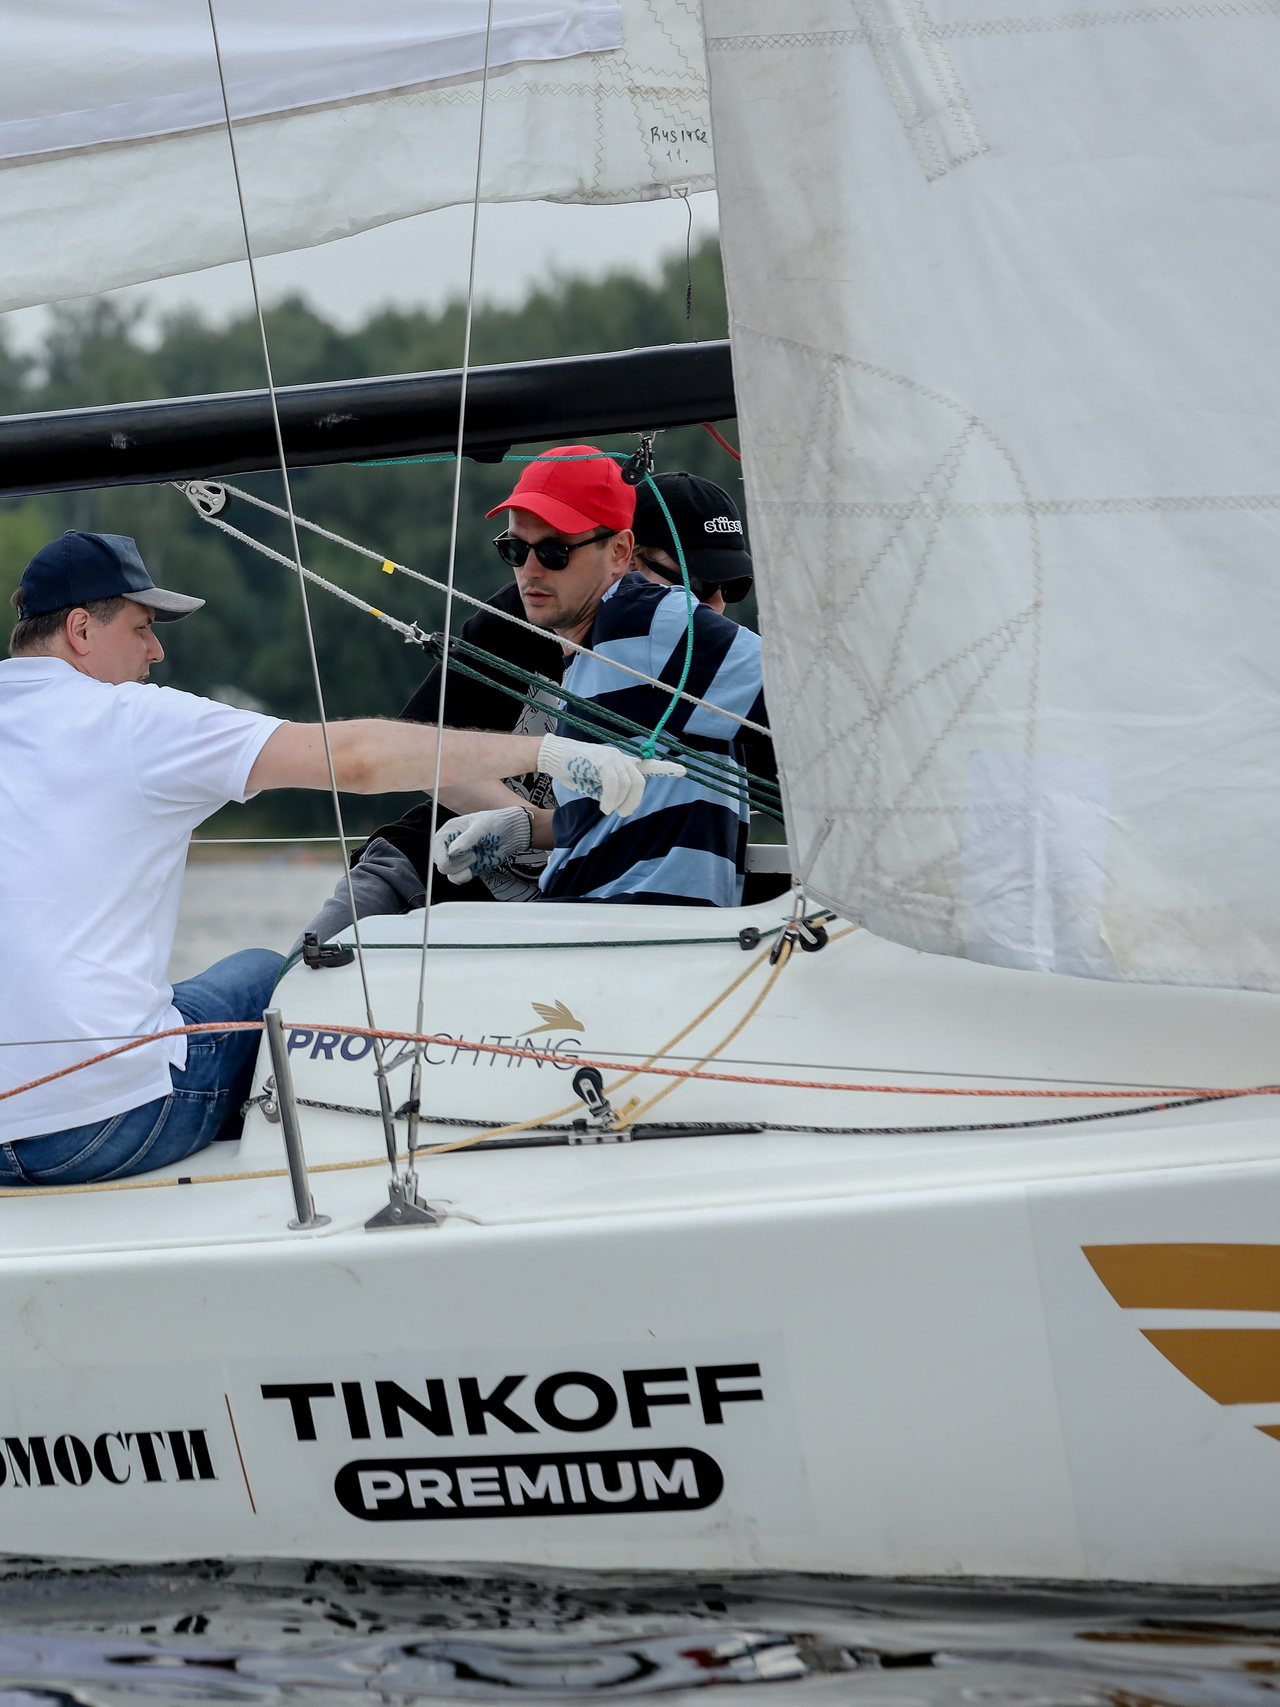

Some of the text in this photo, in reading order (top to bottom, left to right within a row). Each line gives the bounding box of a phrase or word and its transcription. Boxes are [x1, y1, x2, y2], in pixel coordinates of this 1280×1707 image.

[704, 516, 743, 535] stüss
[260, 1362, 765, 1442] TINKOFF
[356, 1458, 701, 1511] PREMIUM
